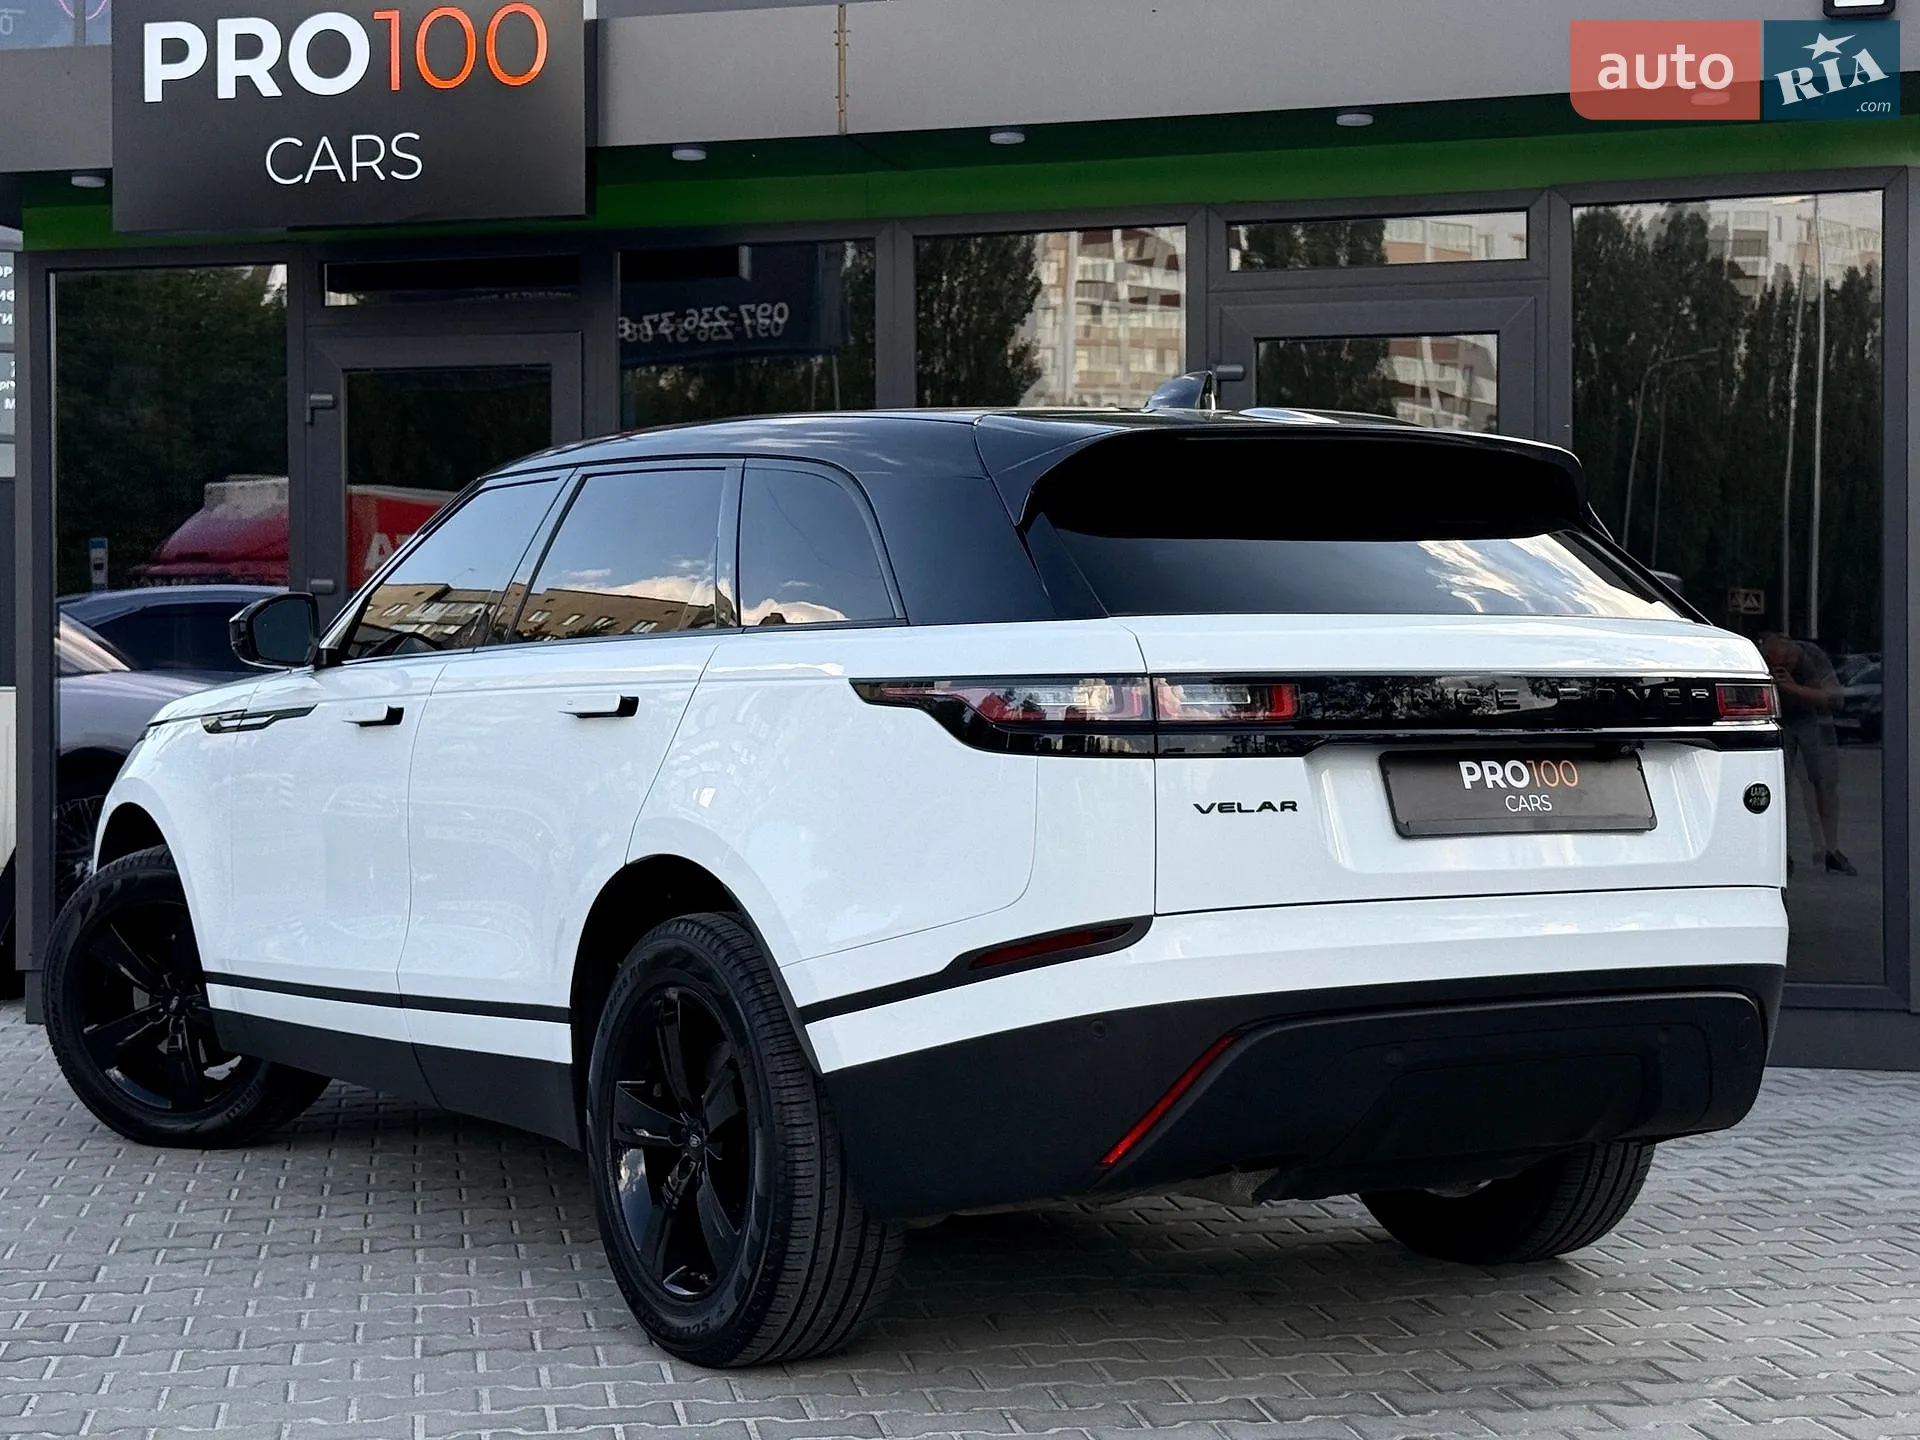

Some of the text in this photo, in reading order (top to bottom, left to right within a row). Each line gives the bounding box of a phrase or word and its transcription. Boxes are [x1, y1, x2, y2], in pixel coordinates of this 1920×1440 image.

[143, 2, 549, 103] PRO100
[265, 131, 424, 185] CARS
[1459, 760, 1578, 790] PRO100
[1193, 800, 1298, 815] VELAR
[1505, 794, 1553, 813] CARS
